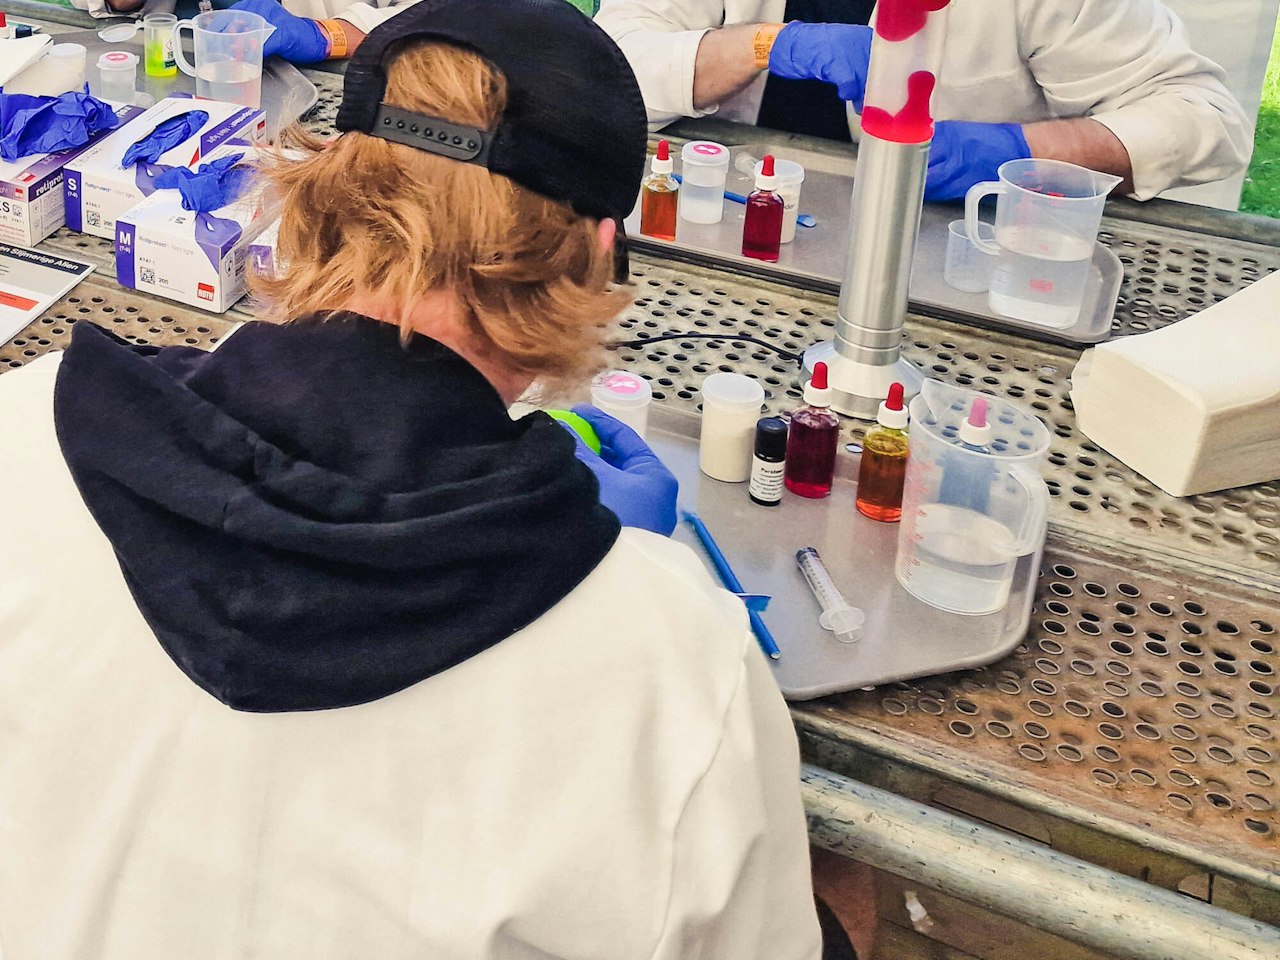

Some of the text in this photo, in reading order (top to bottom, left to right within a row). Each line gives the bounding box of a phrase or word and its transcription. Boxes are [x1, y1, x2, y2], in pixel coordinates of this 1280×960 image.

[67, 178, 78, 191] S
[120, 231, 131, 245] M
[10, 247, 55, 267] Slijmerige
[54, 257, 80, 271] Alien
